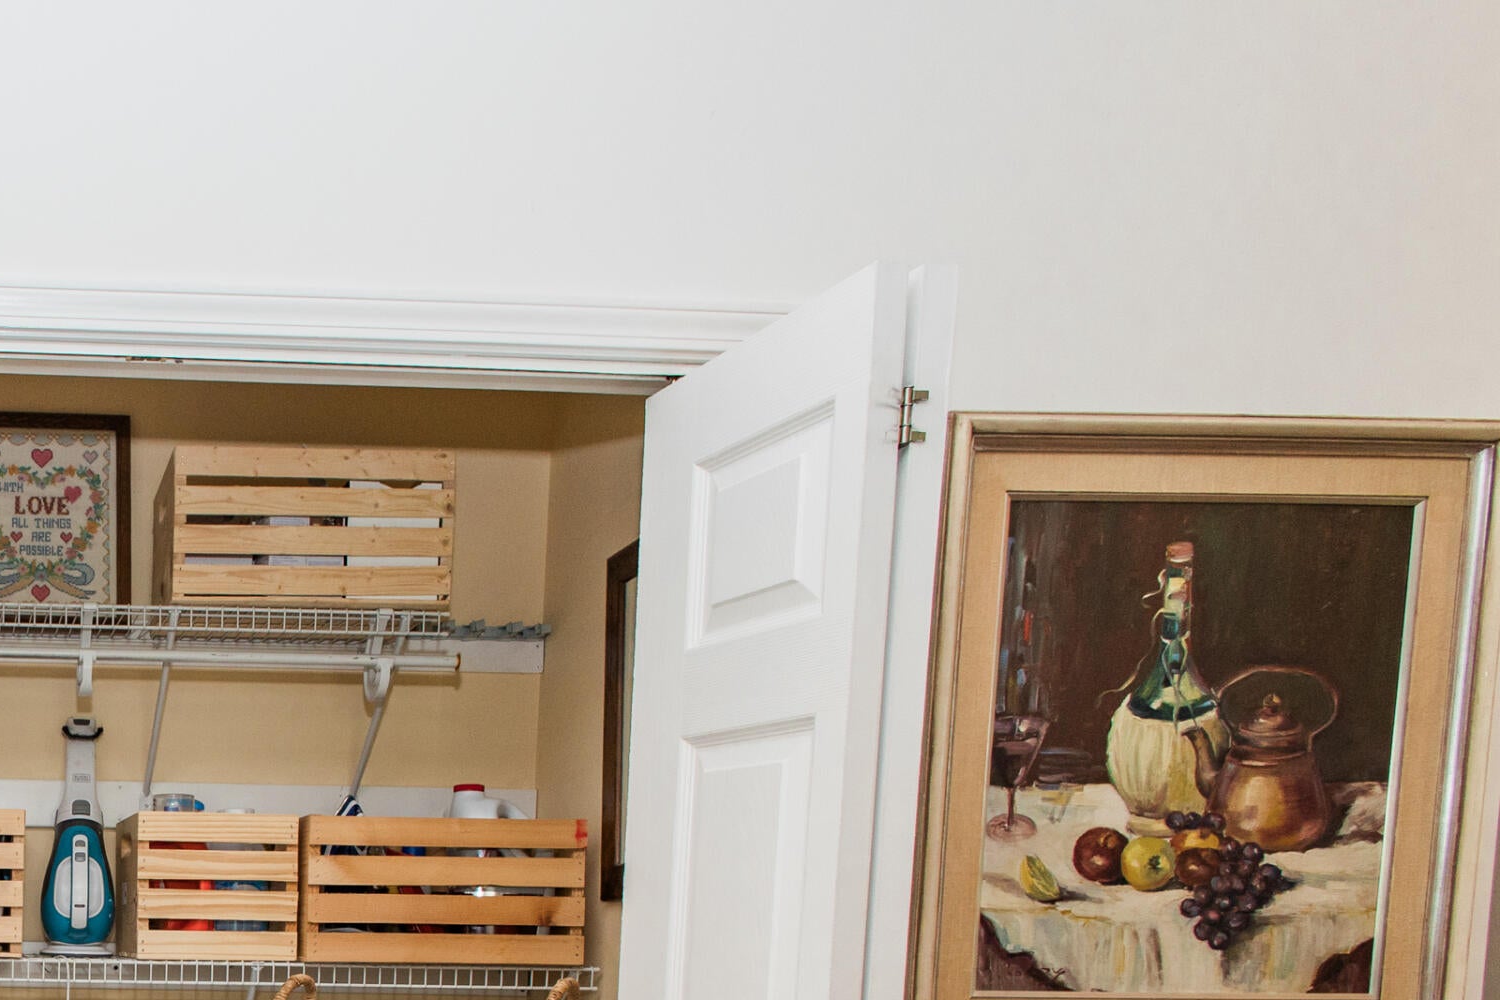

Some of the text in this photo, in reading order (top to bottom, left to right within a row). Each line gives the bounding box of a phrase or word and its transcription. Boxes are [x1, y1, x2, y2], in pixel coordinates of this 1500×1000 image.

[14, 496, 69, 515] LOVE
[11, 518, 71, 529] ALL THINGS
[31, 531, 51, 542] ARE
[19, 545, 63, 556] POSSIBLE
